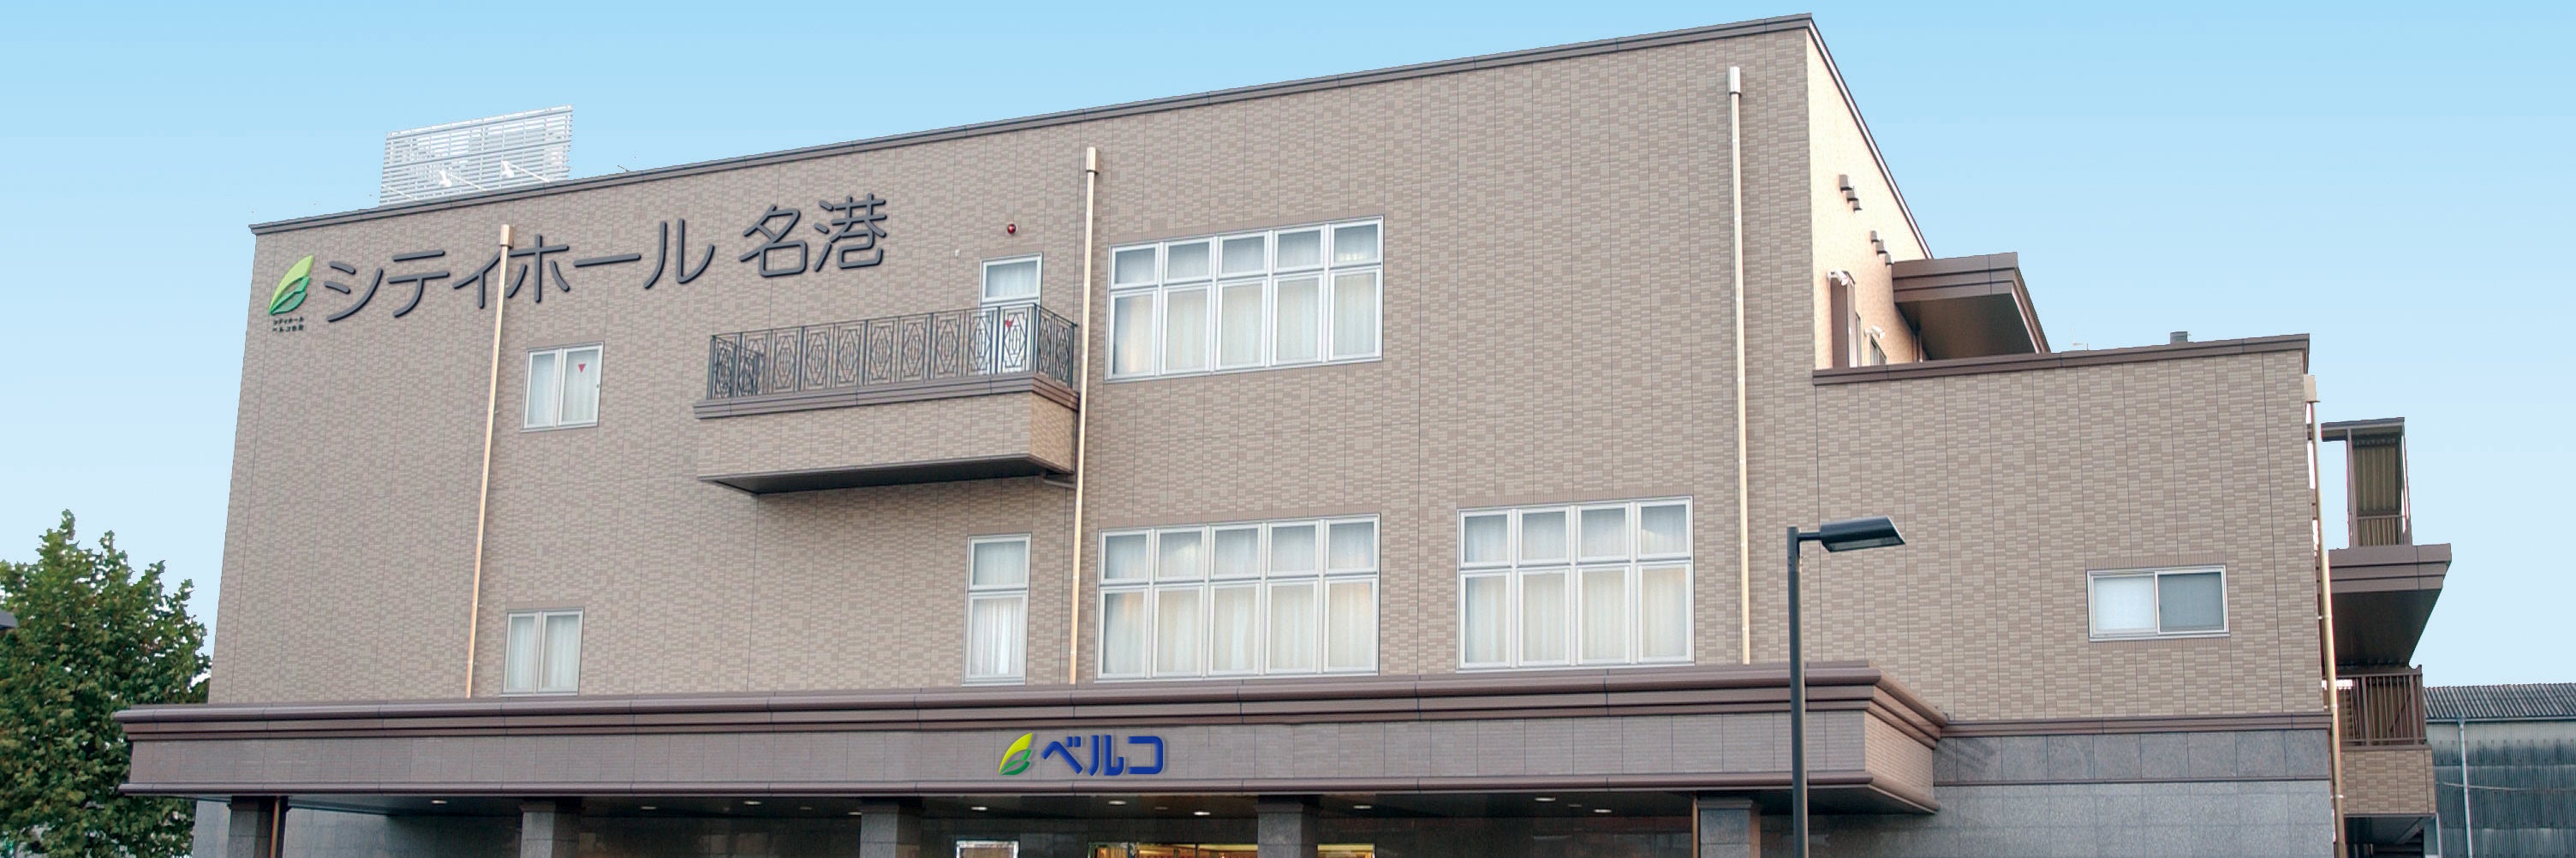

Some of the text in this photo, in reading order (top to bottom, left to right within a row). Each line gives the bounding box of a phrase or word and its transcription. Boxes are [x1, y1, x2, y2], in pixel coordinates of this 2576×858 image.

[323, 193, 888, 322] シティホール 名港
[1041, 735, 1164, 776] ベルコ
